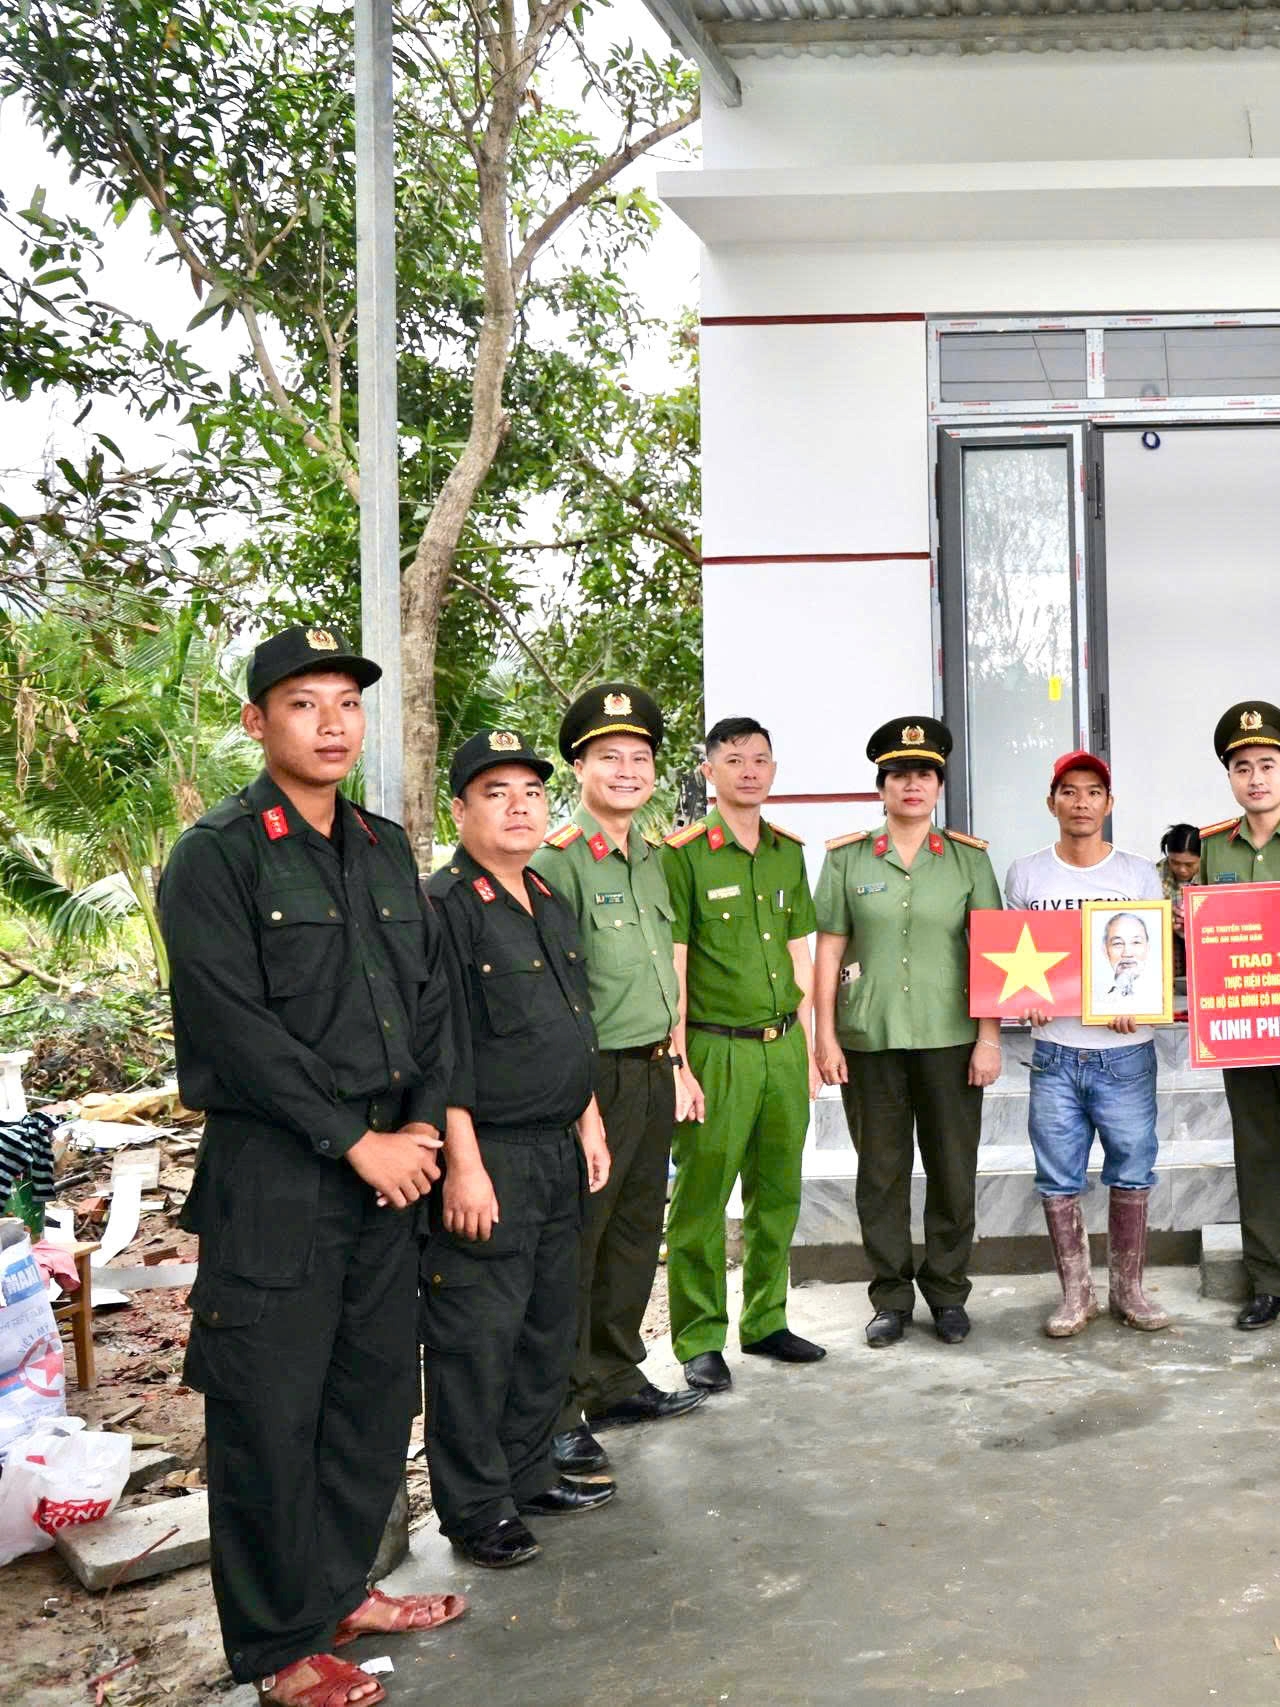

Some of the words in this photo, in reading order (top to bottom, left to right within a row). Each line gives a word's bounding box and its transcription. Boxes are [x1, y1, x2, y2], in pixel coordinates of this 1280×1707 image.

[1030, 898, 1138, 910] GIVE
[1229, 954, 1272, 968] TRAO
[1224, 975, 1242, 990] THỰC
[1243, 973, 1260, 989] HIỆN
[1261, 972, 1280, 986] CÔNG
[1200, 997, 1215, 1009] CHO
[1215, 994, 1226, 1011] HỘ
[1227, 996, 1240, 1008] GIA
[1241, 993, 1258, 1008] ĐÌNH
[1259, 992, 1270, 1006] CÓ
[1210, 1018, 1252, 1041] KINH
